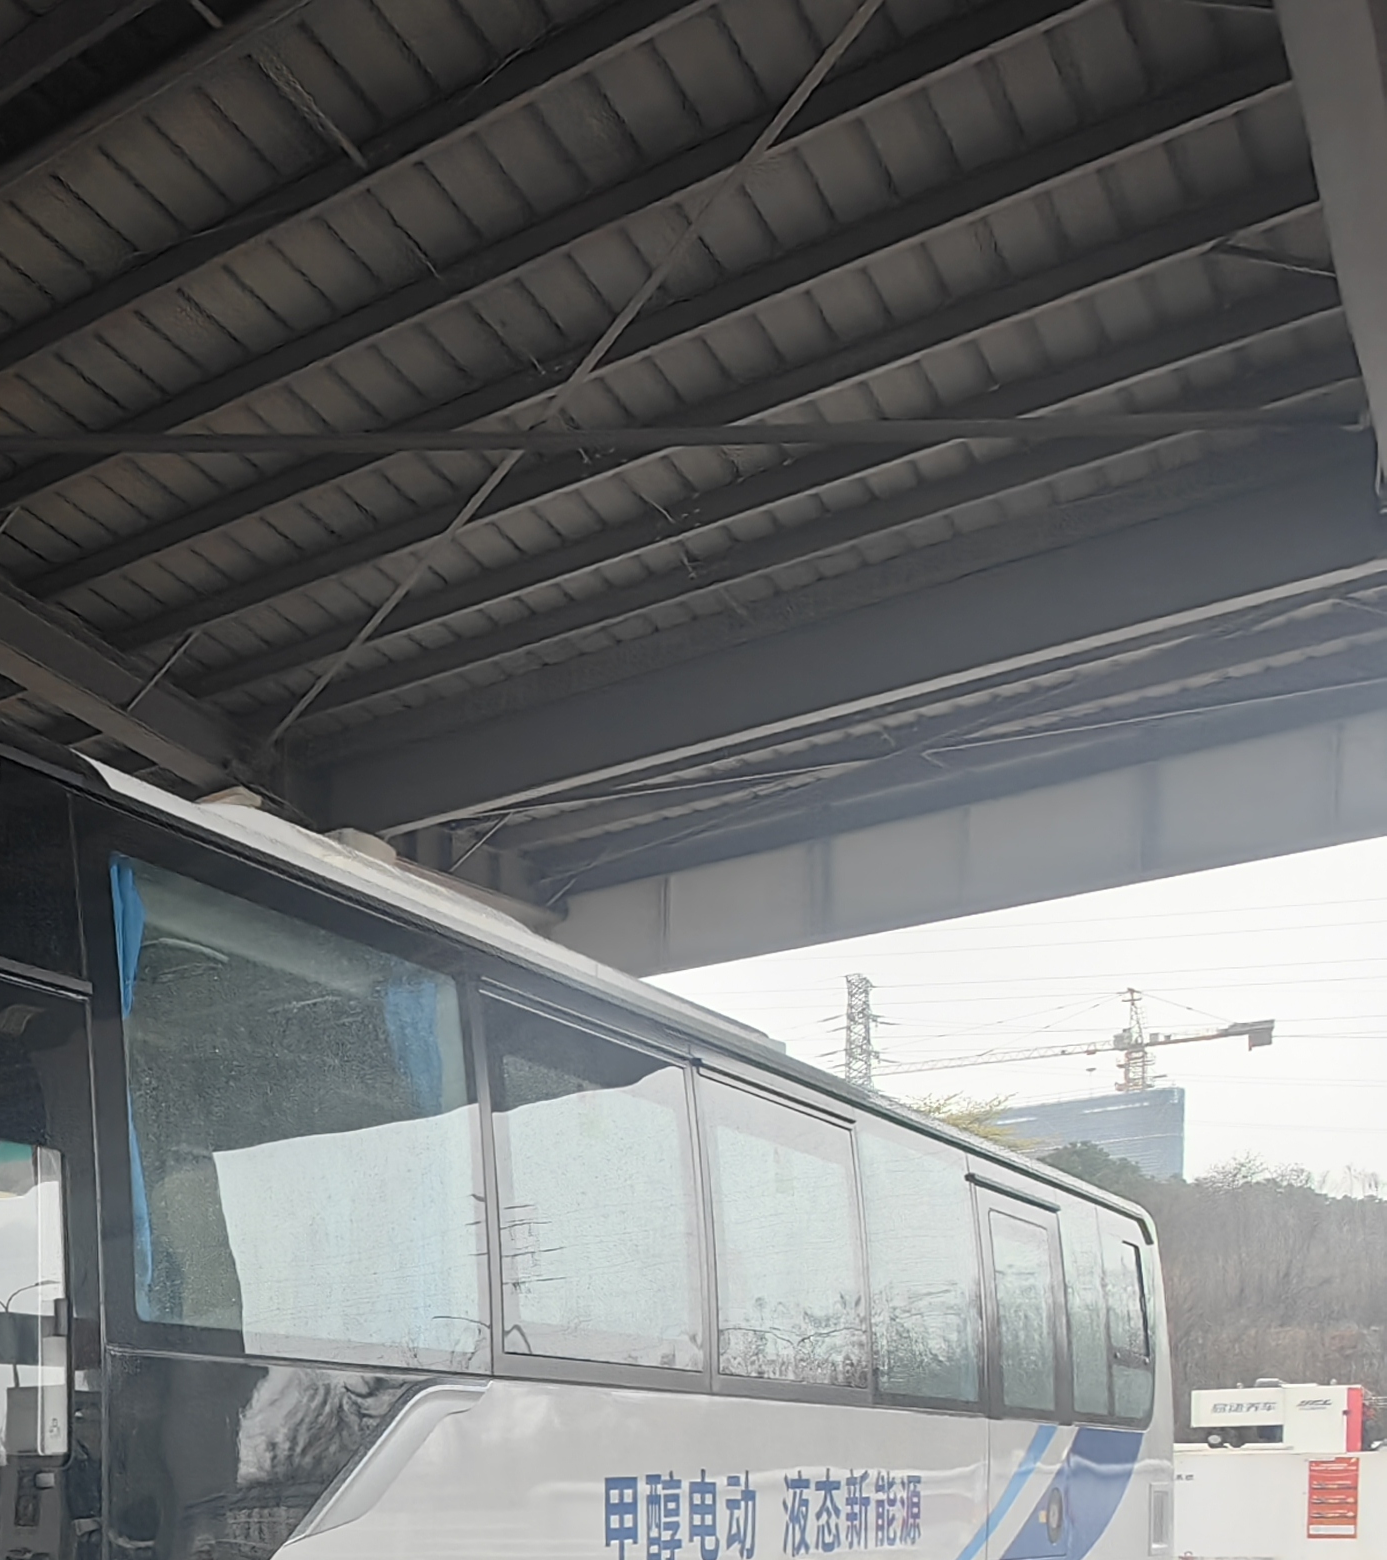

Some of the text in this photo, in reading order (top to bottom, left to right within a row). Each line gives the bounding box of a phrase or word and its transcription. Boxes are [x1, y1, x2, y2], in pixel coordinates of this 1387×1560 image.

[783, 1467, 922, 1558] 液态新能源
